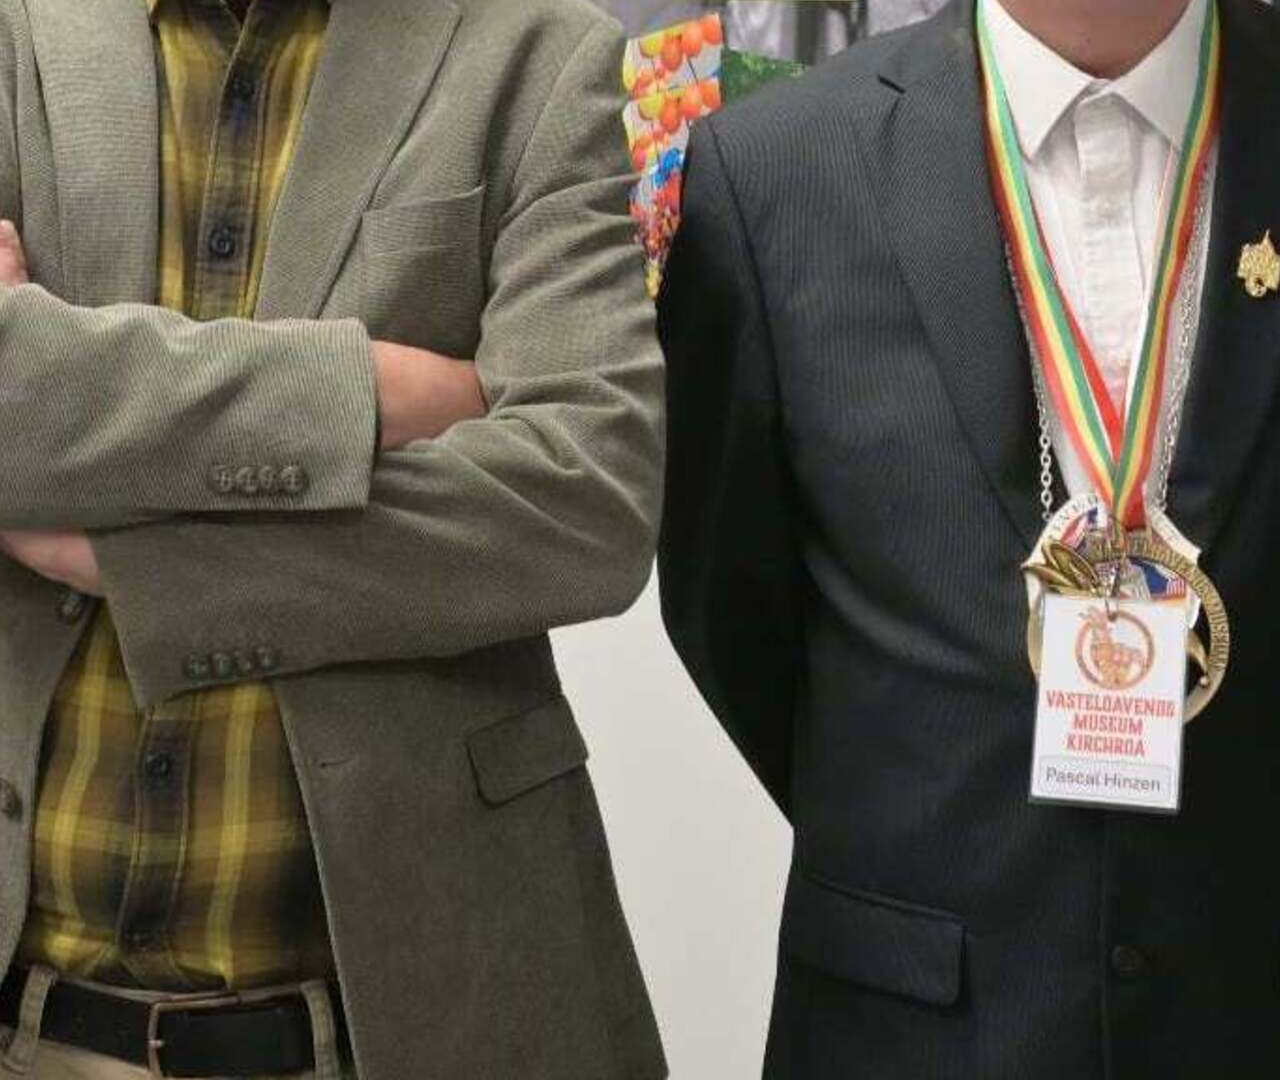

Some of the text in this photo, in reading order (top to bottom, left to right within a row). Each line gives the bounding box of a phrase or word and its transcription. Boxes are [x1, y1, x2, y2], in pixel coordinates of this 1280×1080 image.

[1073, 714, 1144, 737] MUSEUM
[1046, 766, 1161, 793] Pascal Hinzen
